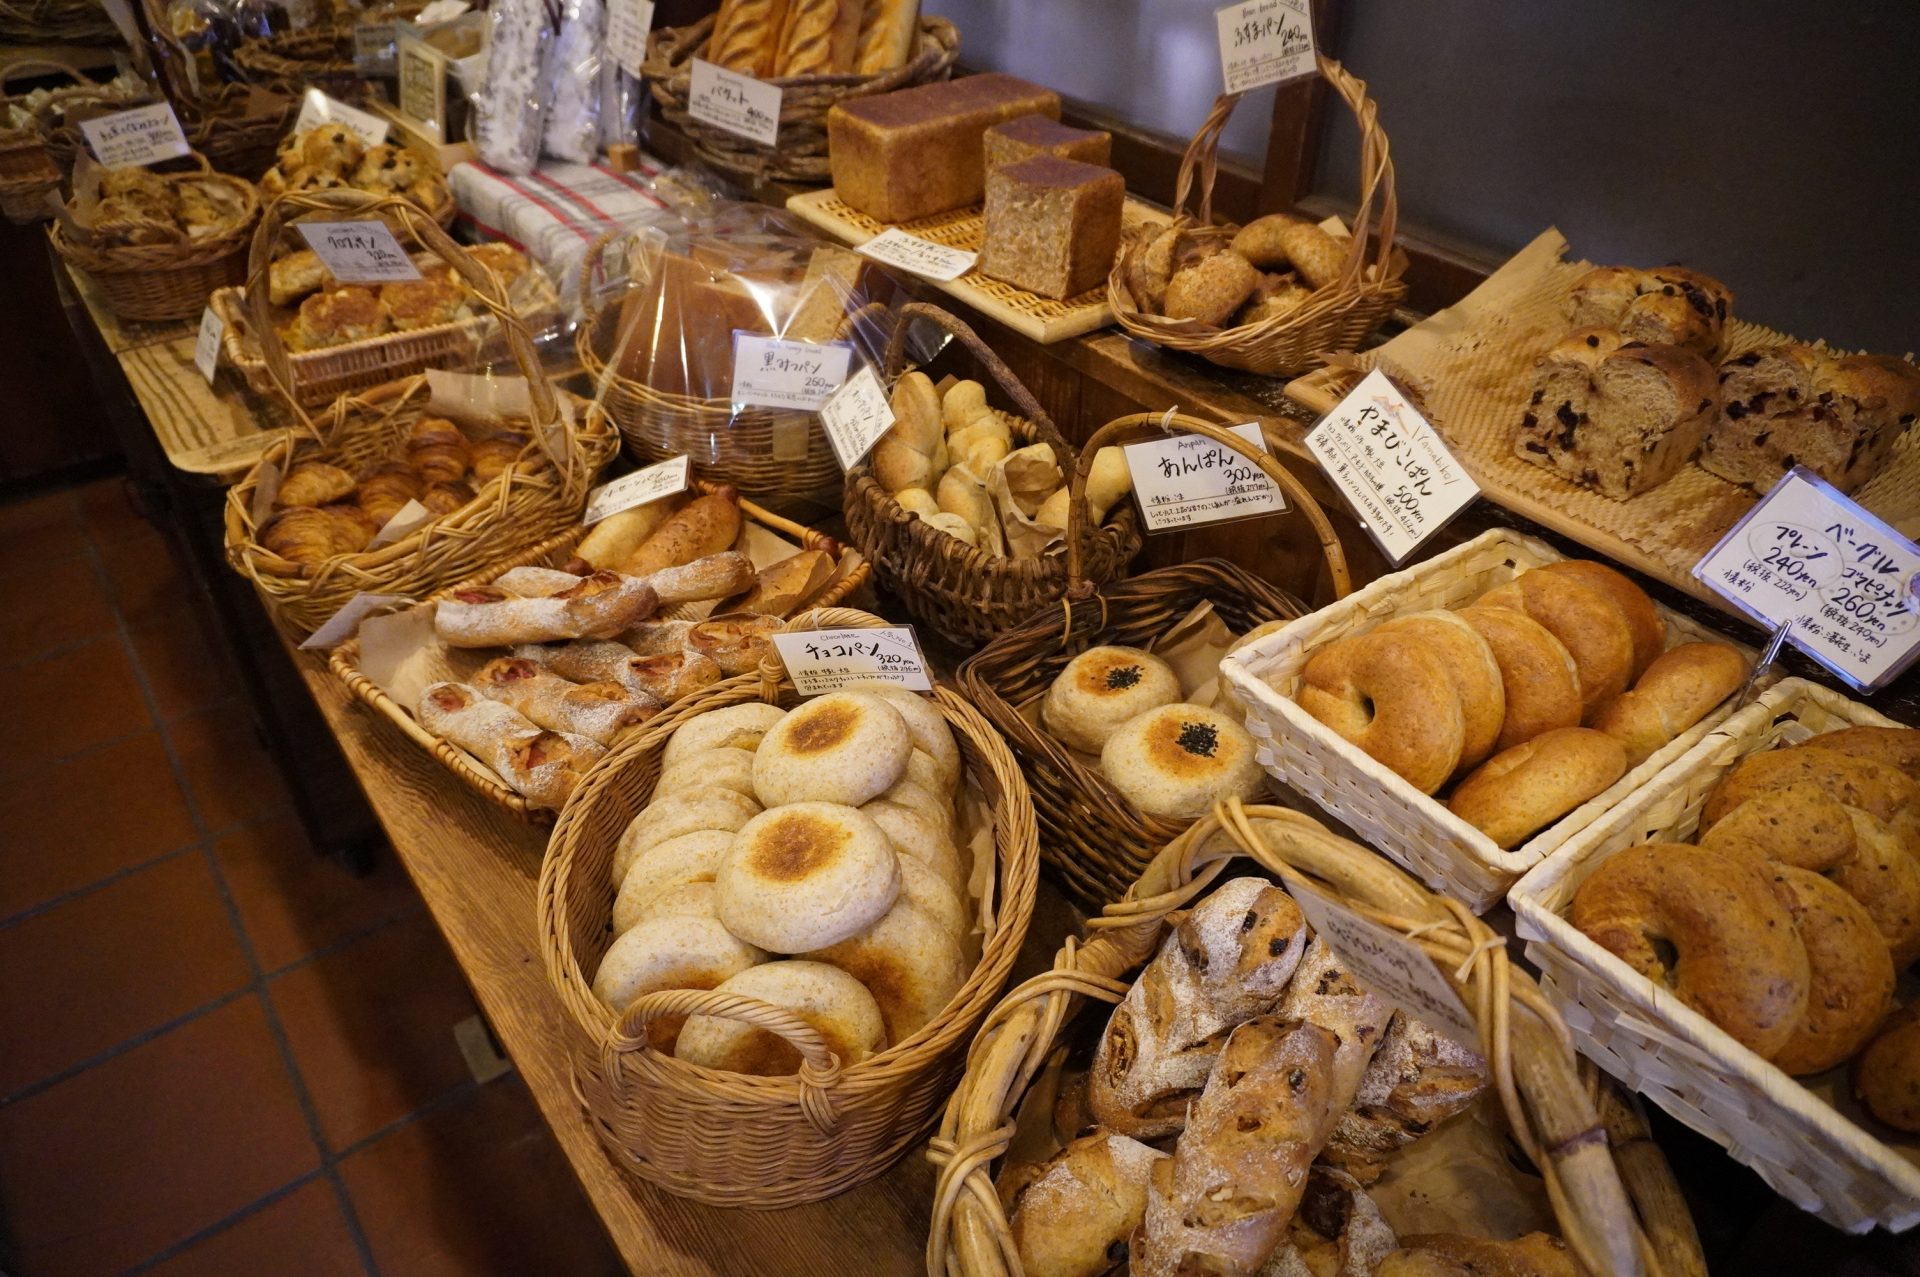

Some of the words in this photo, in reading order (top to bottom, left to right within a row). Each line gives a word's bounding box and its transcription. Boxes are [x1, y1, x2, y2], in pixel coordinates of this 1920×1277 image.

[1158, 447, 1234, 478] あんぱん
[1359, 405, 1433, 496] やまびこぱん
[1223, 466, 1265, 485] 300yen
[1392, 484, 1424, 523] 500yen
[1776, 525, 1828, 560] プレーン
[1824, 522, 1900, 574] ベーグル
[1762, 546, 1817, 589] 240yen
[1830, 586, 1893, 631] 260yen
[805, 642, 880, 661] チョコパン
[876, 654, 914, 666] 320yen
